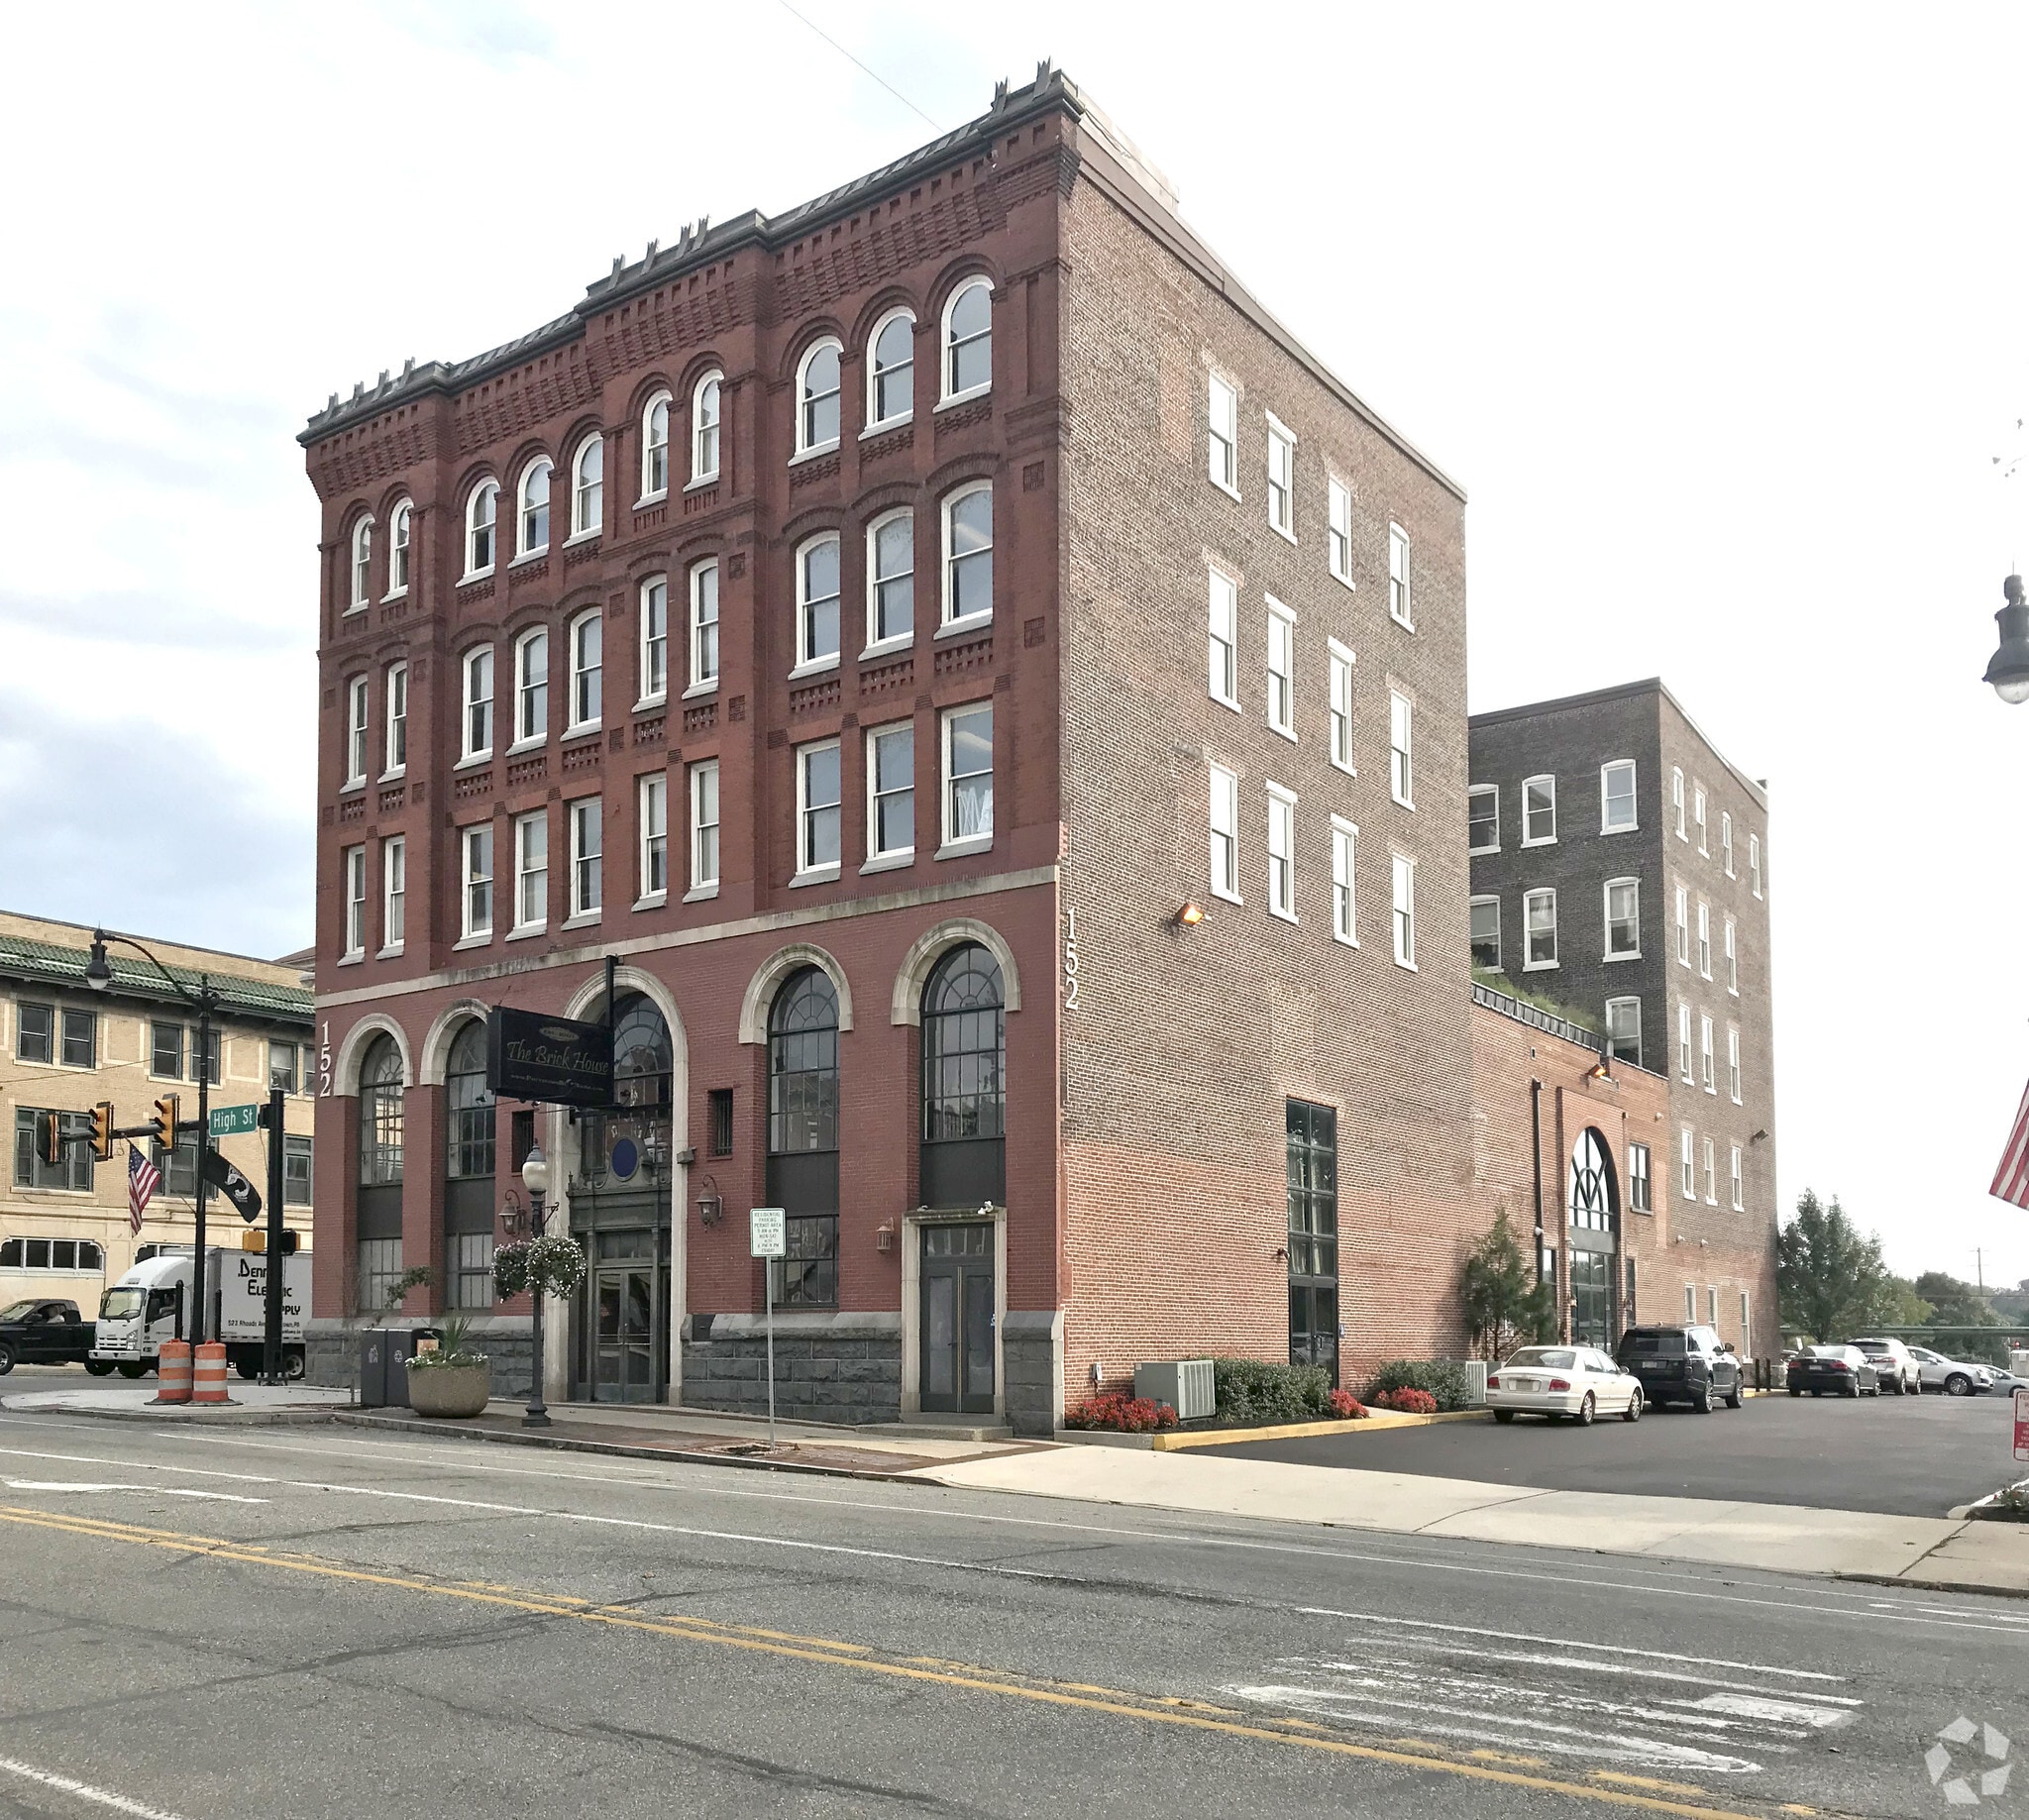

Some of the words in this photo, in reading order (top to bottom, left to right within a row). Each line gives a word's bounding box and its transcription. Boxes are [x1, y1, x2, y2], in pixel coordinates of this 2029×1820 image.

[1065, 908, 1079, 1011] 152
[319, 1019, 332, 1098] 152
[506, 1038, 531, 1061] The
[535, 1045, 571, 1070] Brick
[573, 1052, 609, 1073] House
[213, 1111, 237, 1132] High
[242, 1108, 253, 1125] St
